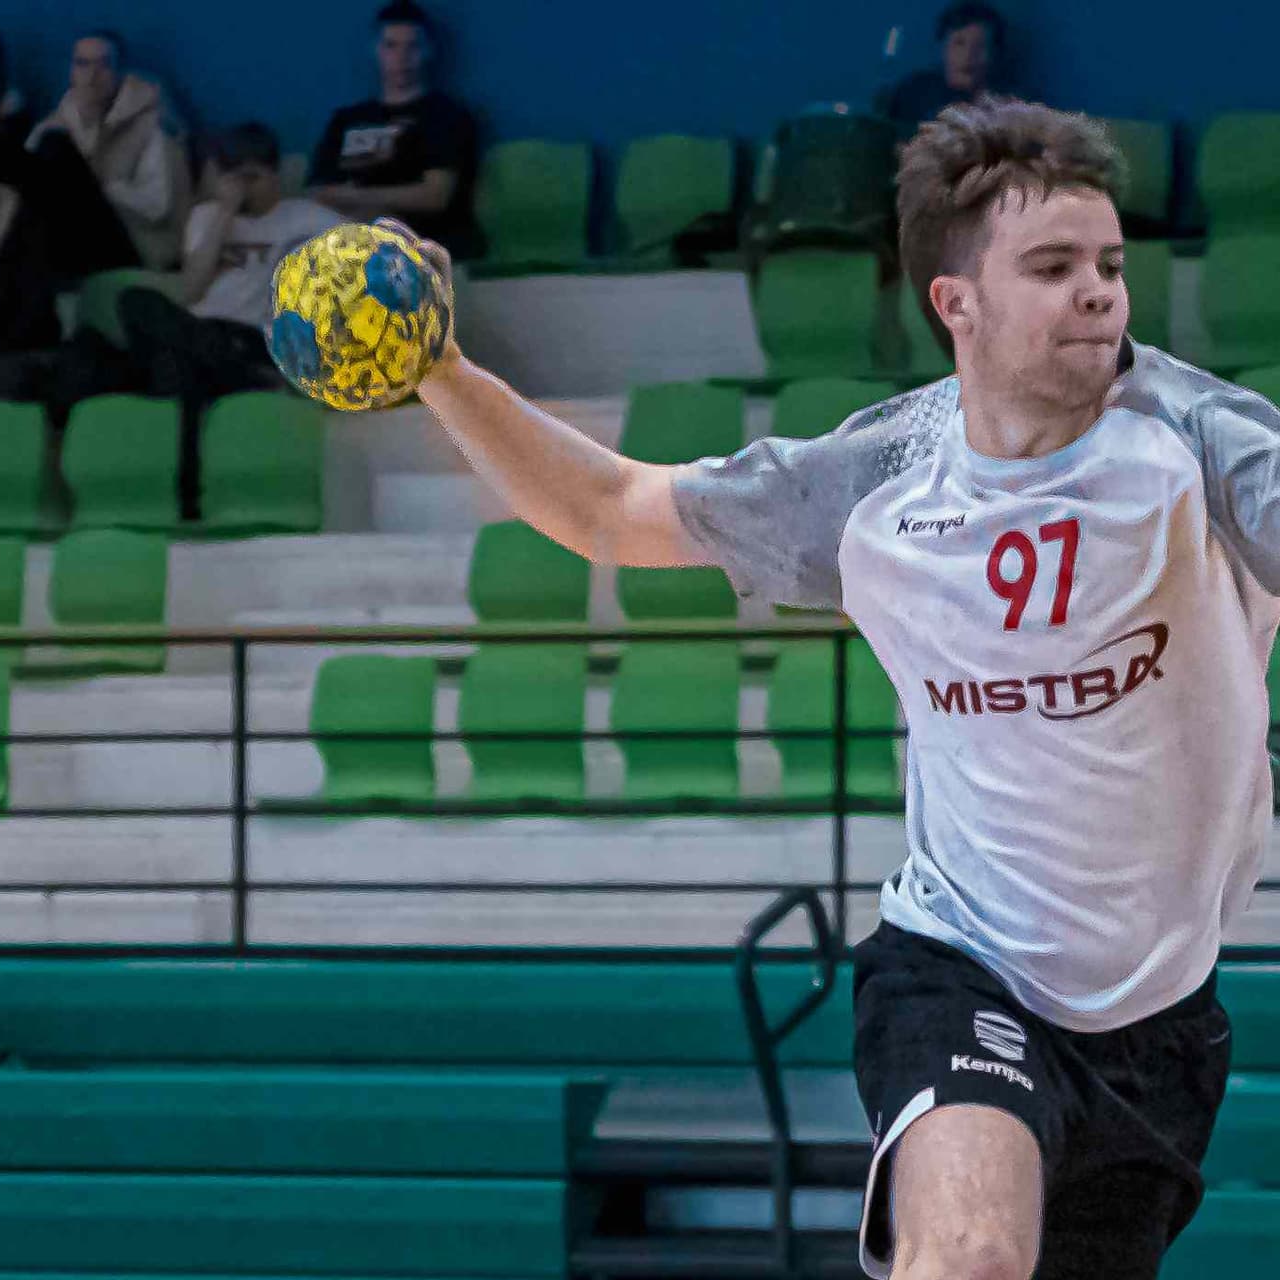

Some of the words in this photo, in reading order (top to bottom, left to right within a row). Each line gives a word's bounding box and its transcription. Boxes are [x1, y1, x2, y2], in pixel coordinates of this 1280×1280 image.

[986, 518, 1081, 632] 97
[923, 650, 1165, 716] MISTRA
[951, 1053, 1035, 1092] Kempa
